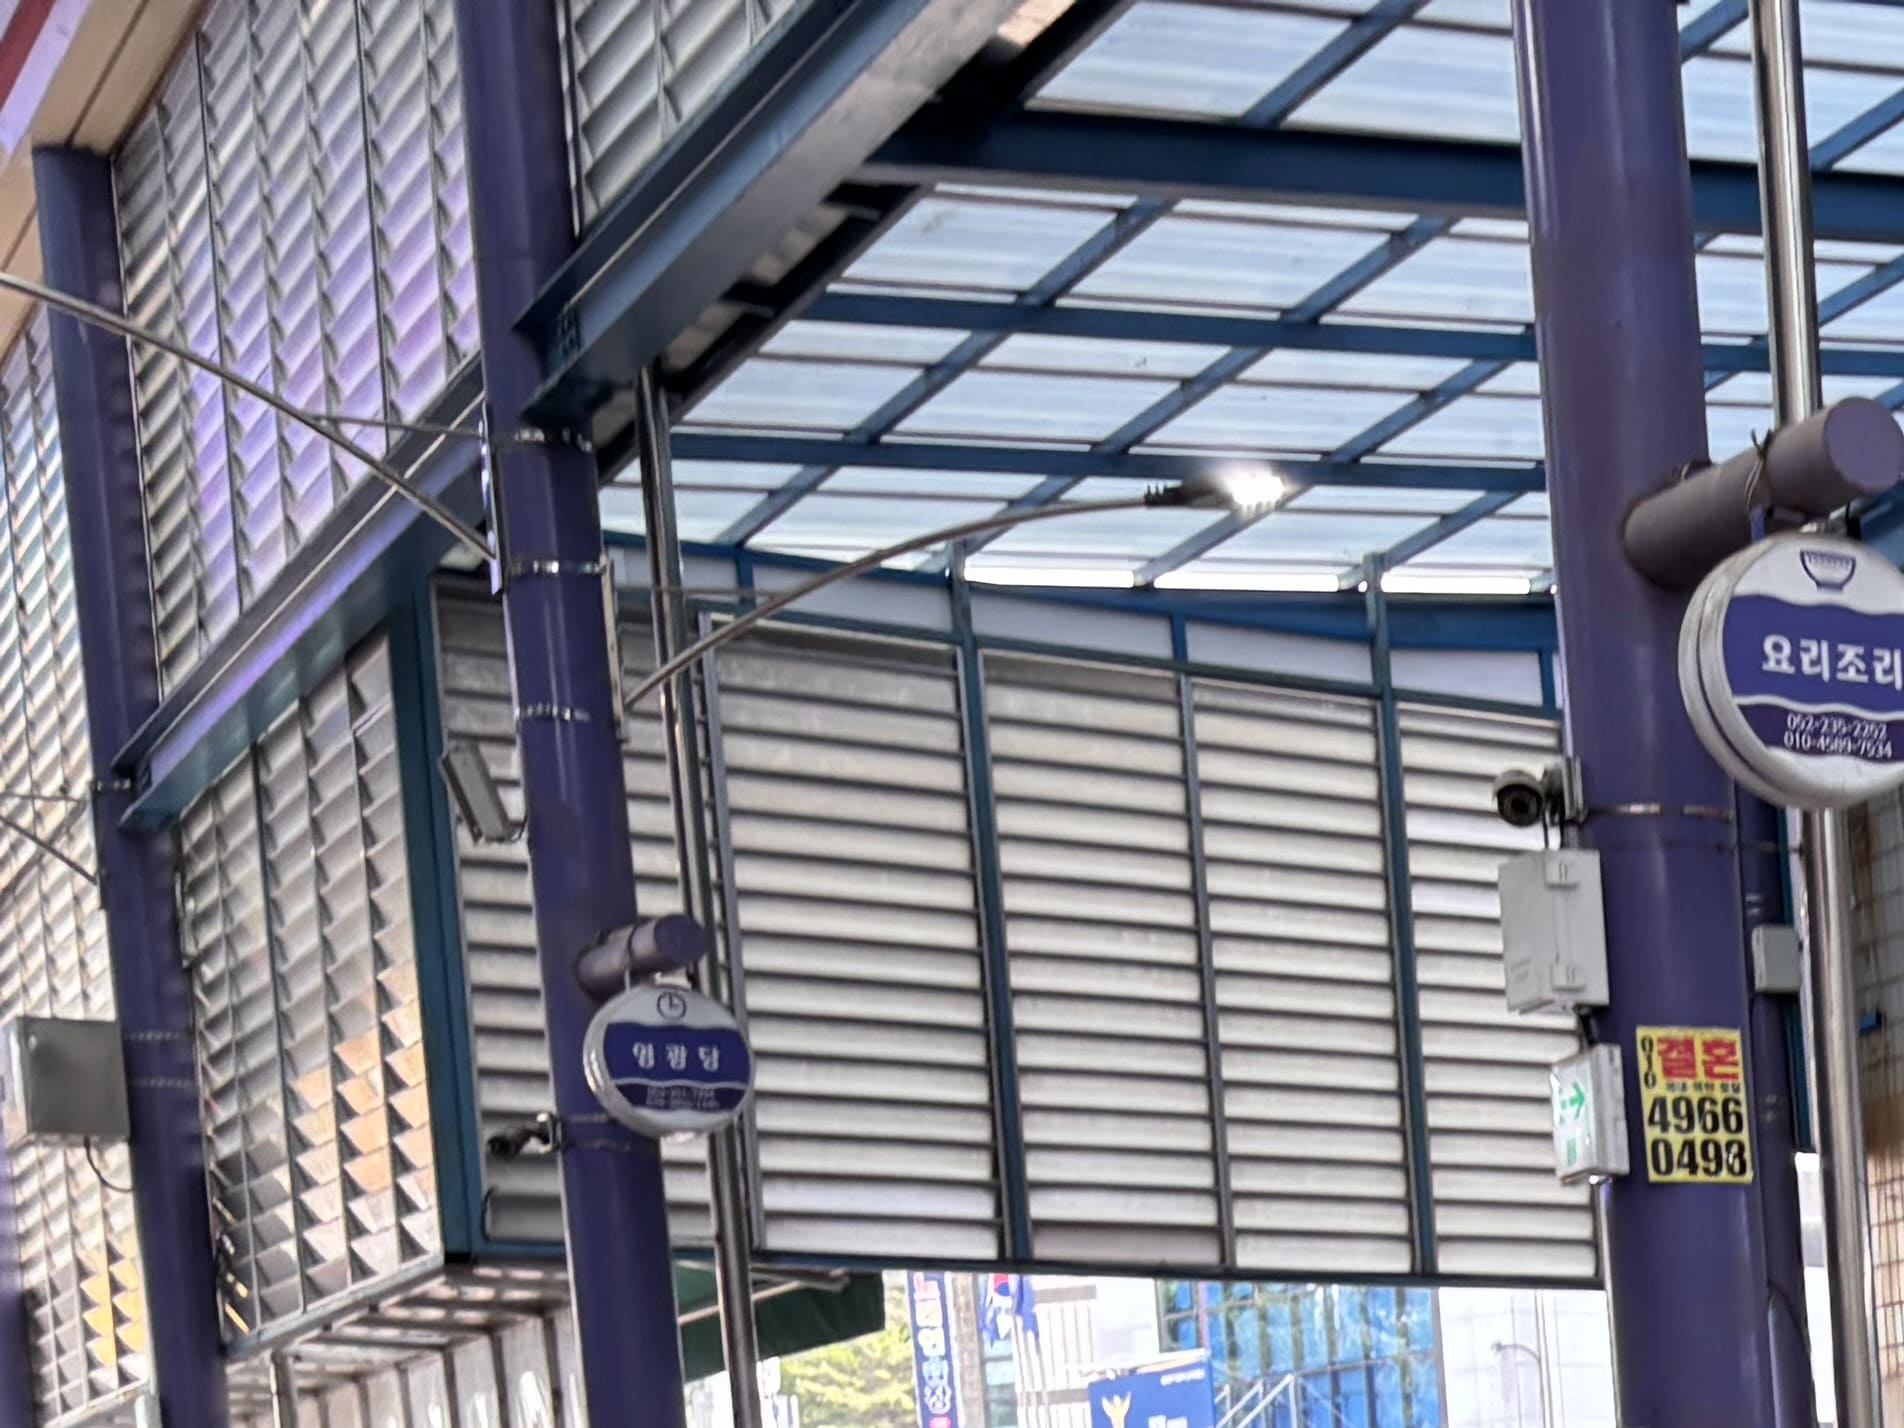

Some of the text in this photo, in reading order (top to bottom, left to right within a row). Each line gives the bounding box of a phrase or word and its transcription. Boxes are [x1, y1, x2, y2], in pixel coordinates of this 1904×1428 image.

[1762, 634, 1903, 691] 요리조리
[1657, 1036, 1740, 1080] 결혼
[1647, 1096, 1744, 1135] 4966
